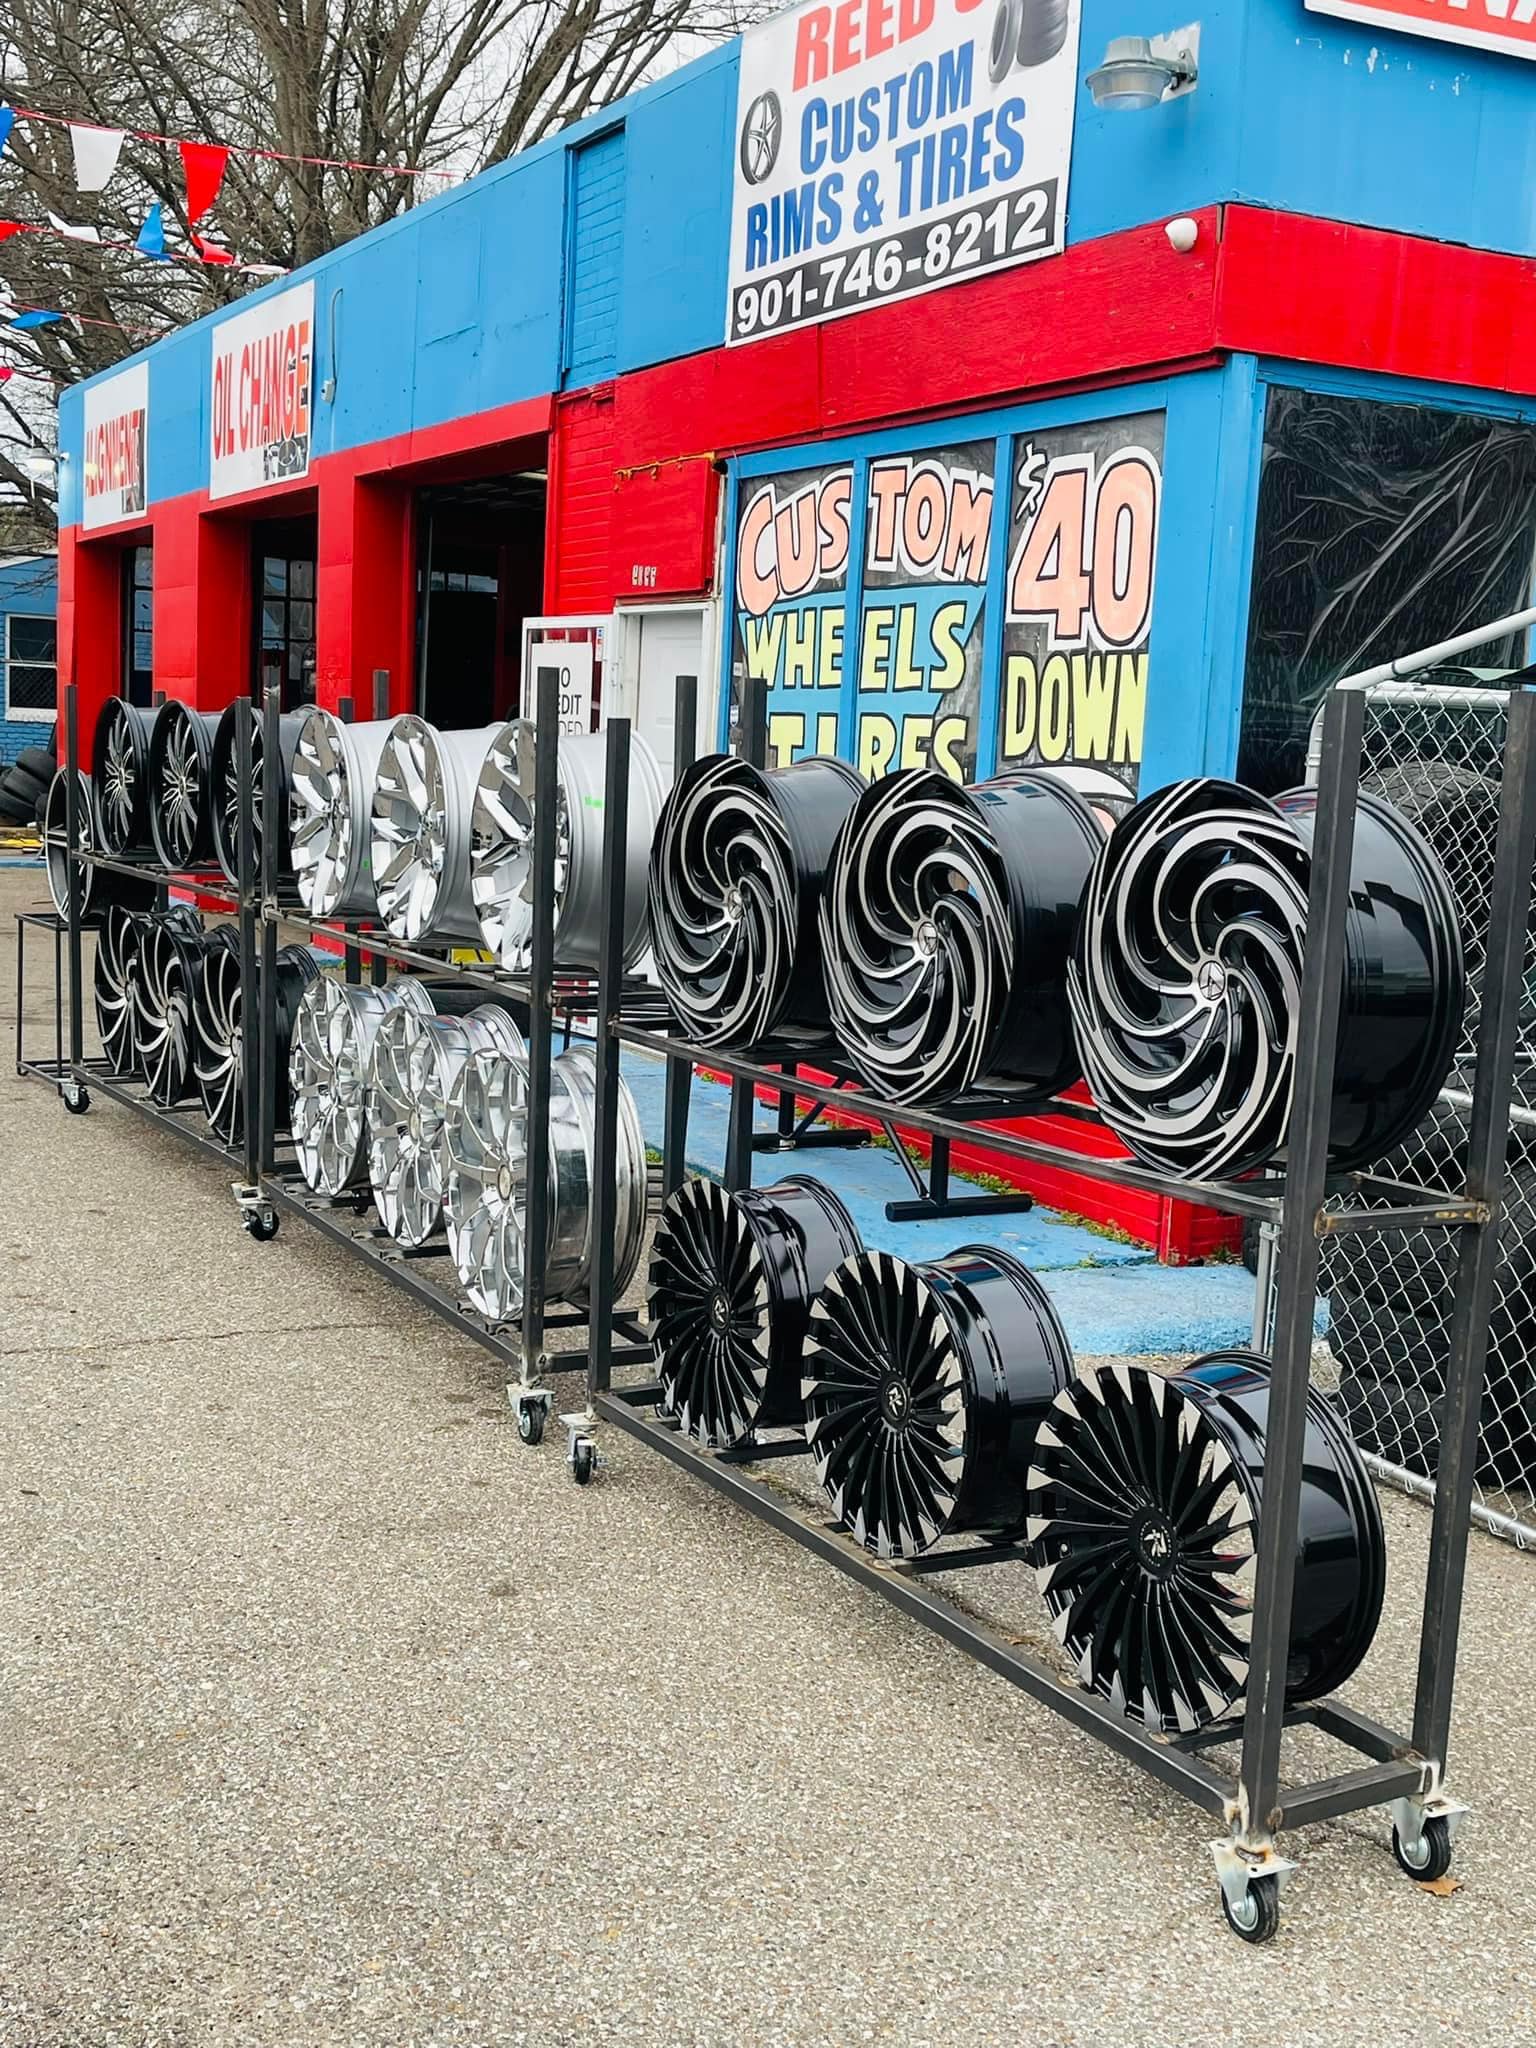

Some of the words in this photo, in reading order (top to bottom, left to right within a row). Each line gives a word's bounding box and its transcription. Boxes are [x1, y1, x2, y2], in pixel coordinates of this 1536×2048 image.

[792, 0, 984, 93] REED
[800, 39, 975, 175] CUSTOM
[745, 172, 844, 273] RIMS
[853, 169, 884, 234] &
[895, 97, 1026, 219] TIRES
[736, 189, 1050, 334] 901-746-8212
[213, 352, 235, 460] OIL
[239, 319, 309, 453] CHANGE
[736, 464, 994, 616] CUSTOM
[1003, 440, 1160, 648] $40
[559, 694, 583, 716] DIT
[743, 600, 968, 694] WHEELS
[1001, 651, 1149, 763] DOWN
